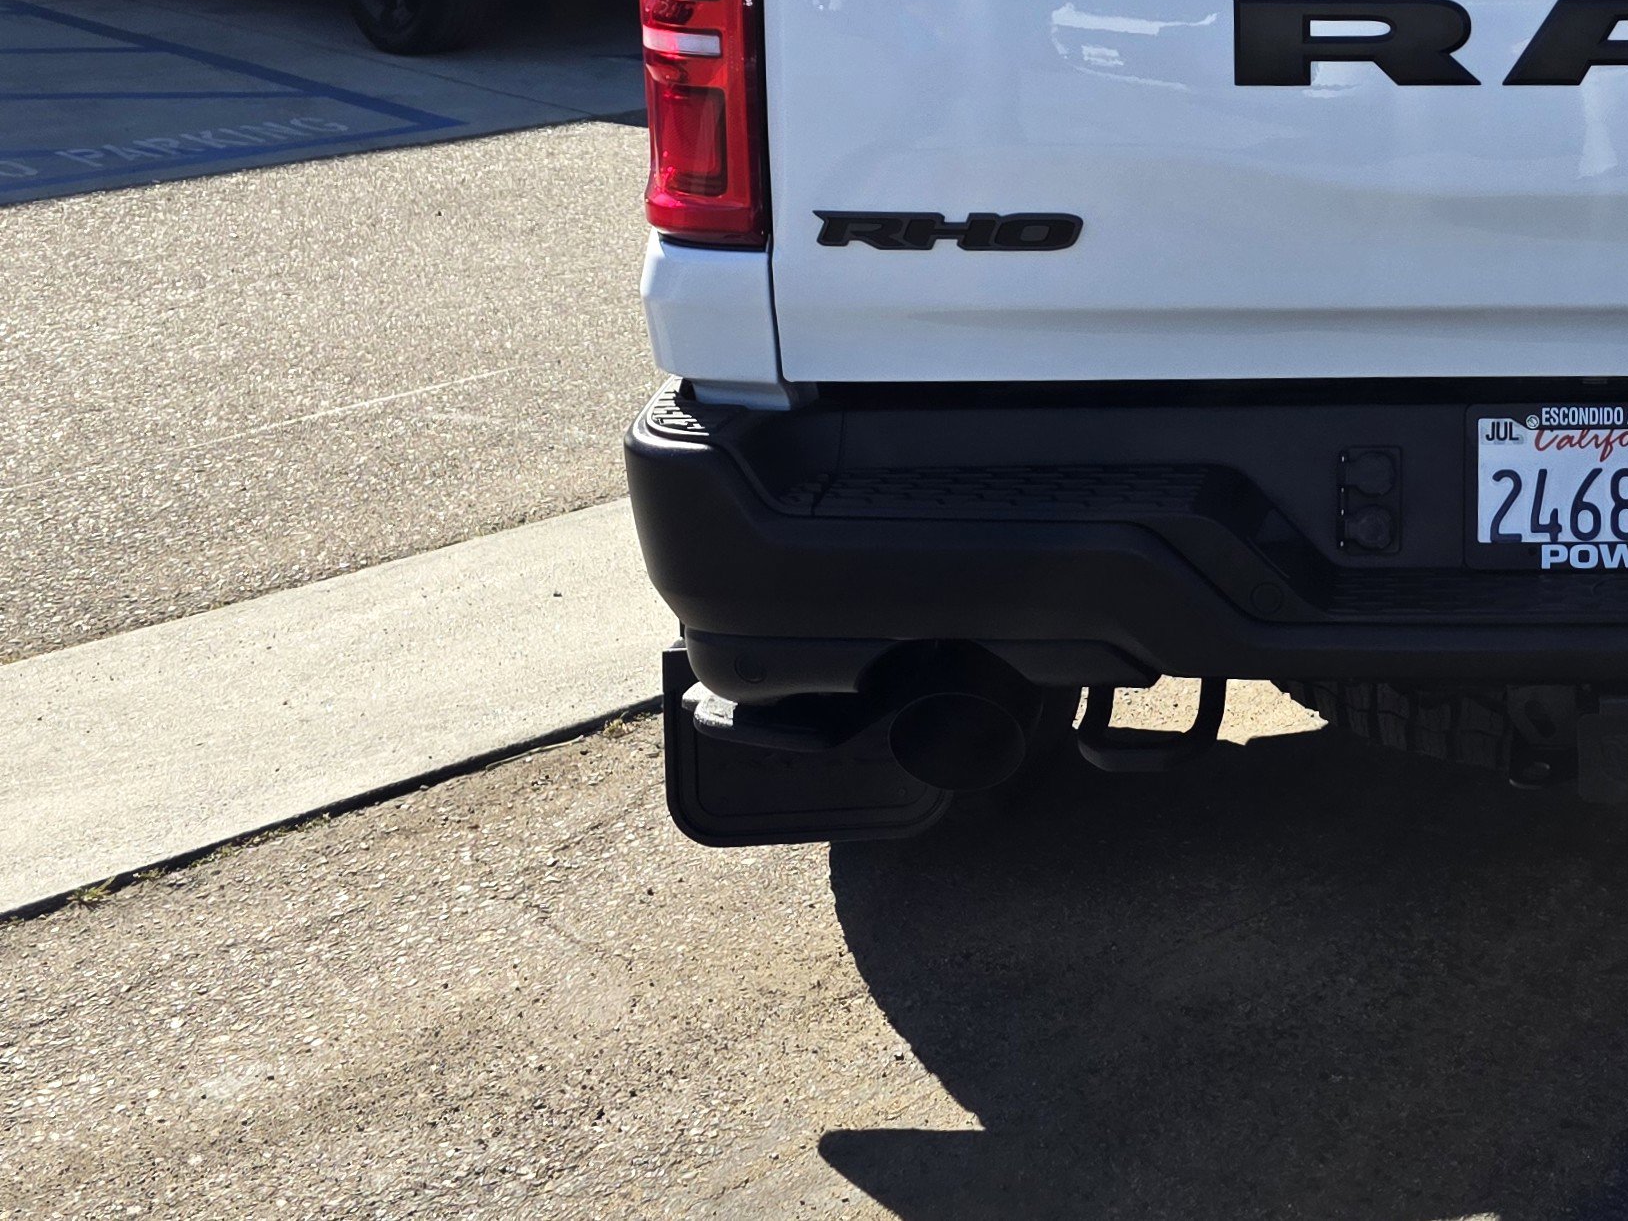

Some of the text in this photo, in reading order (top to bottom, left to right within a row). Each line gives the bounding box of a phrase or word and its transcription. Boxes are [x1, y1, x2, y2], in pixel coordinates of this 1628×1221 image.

[55, 117, 348, 168] PARKING
[811, 209, 1085, 251] RHO
[1485, 421, 1520, 442] JUL
[1541, 407, 1624, 426] ESCONDIDO
